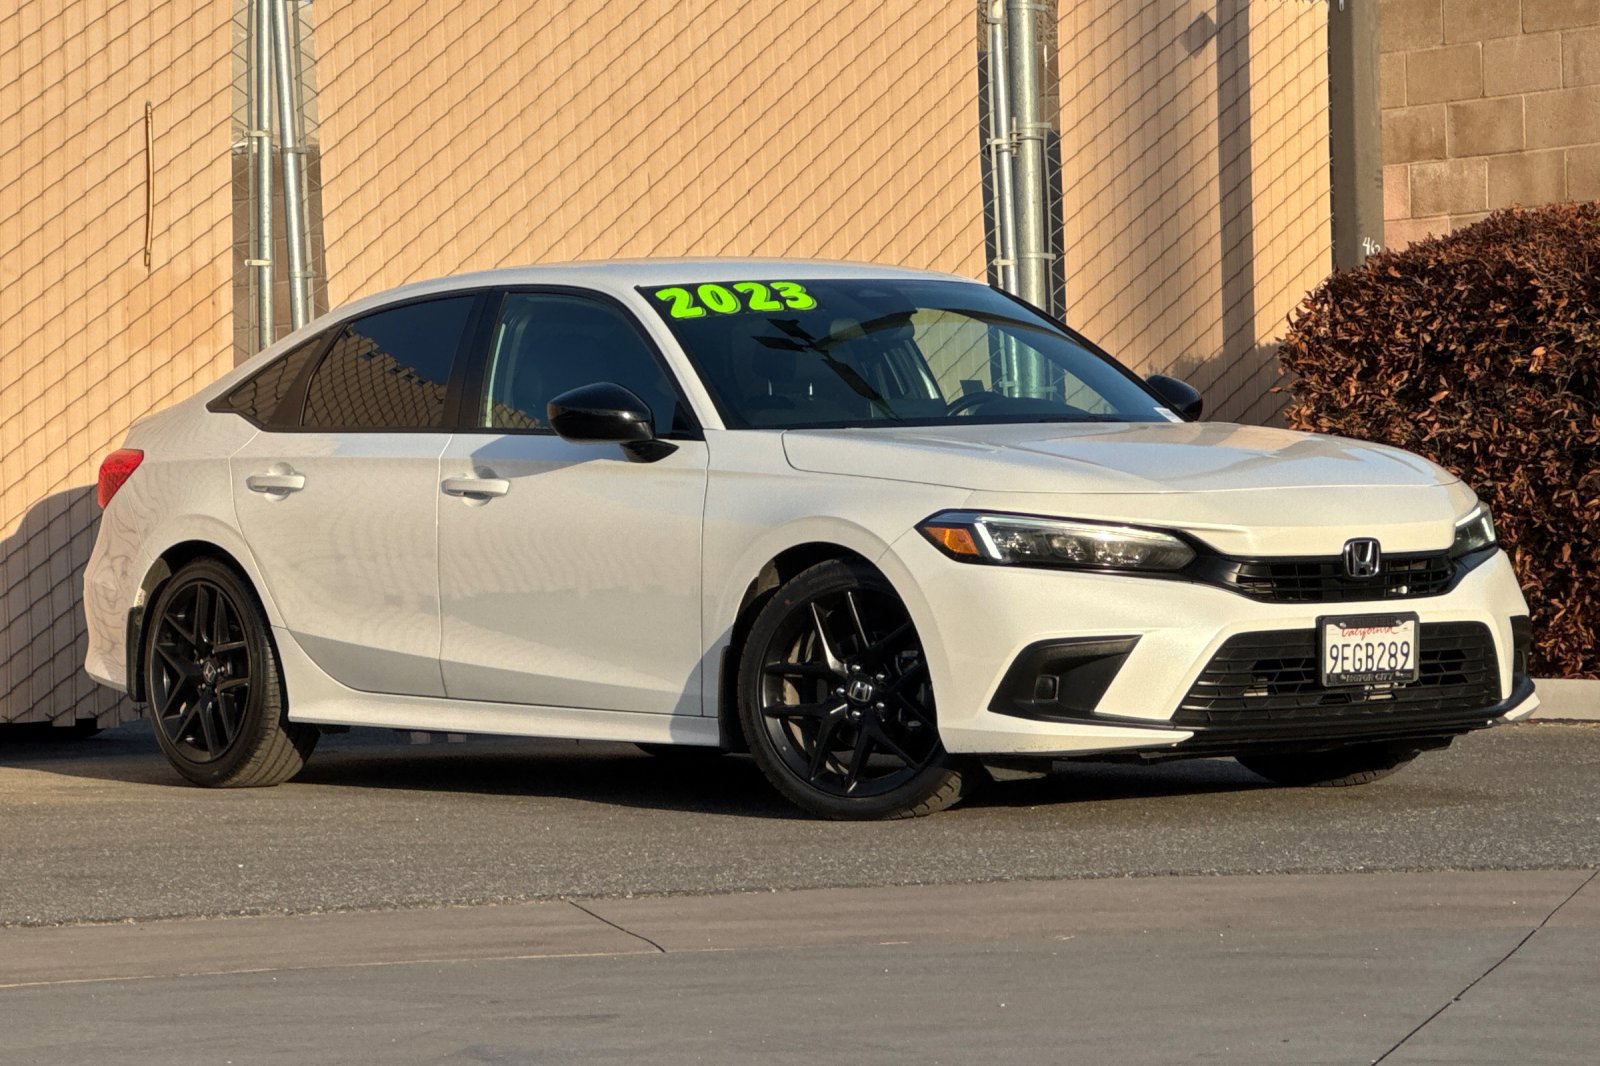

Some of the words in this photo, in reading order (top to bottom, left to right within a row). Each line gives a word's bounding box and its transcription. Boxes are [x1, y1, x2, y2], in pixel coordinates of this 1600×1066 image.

[655, 281, 817, 319] 2023
[1329, 640, 1411, 674] 9EGB289
[1375, 672, 1394, 682] CITY
